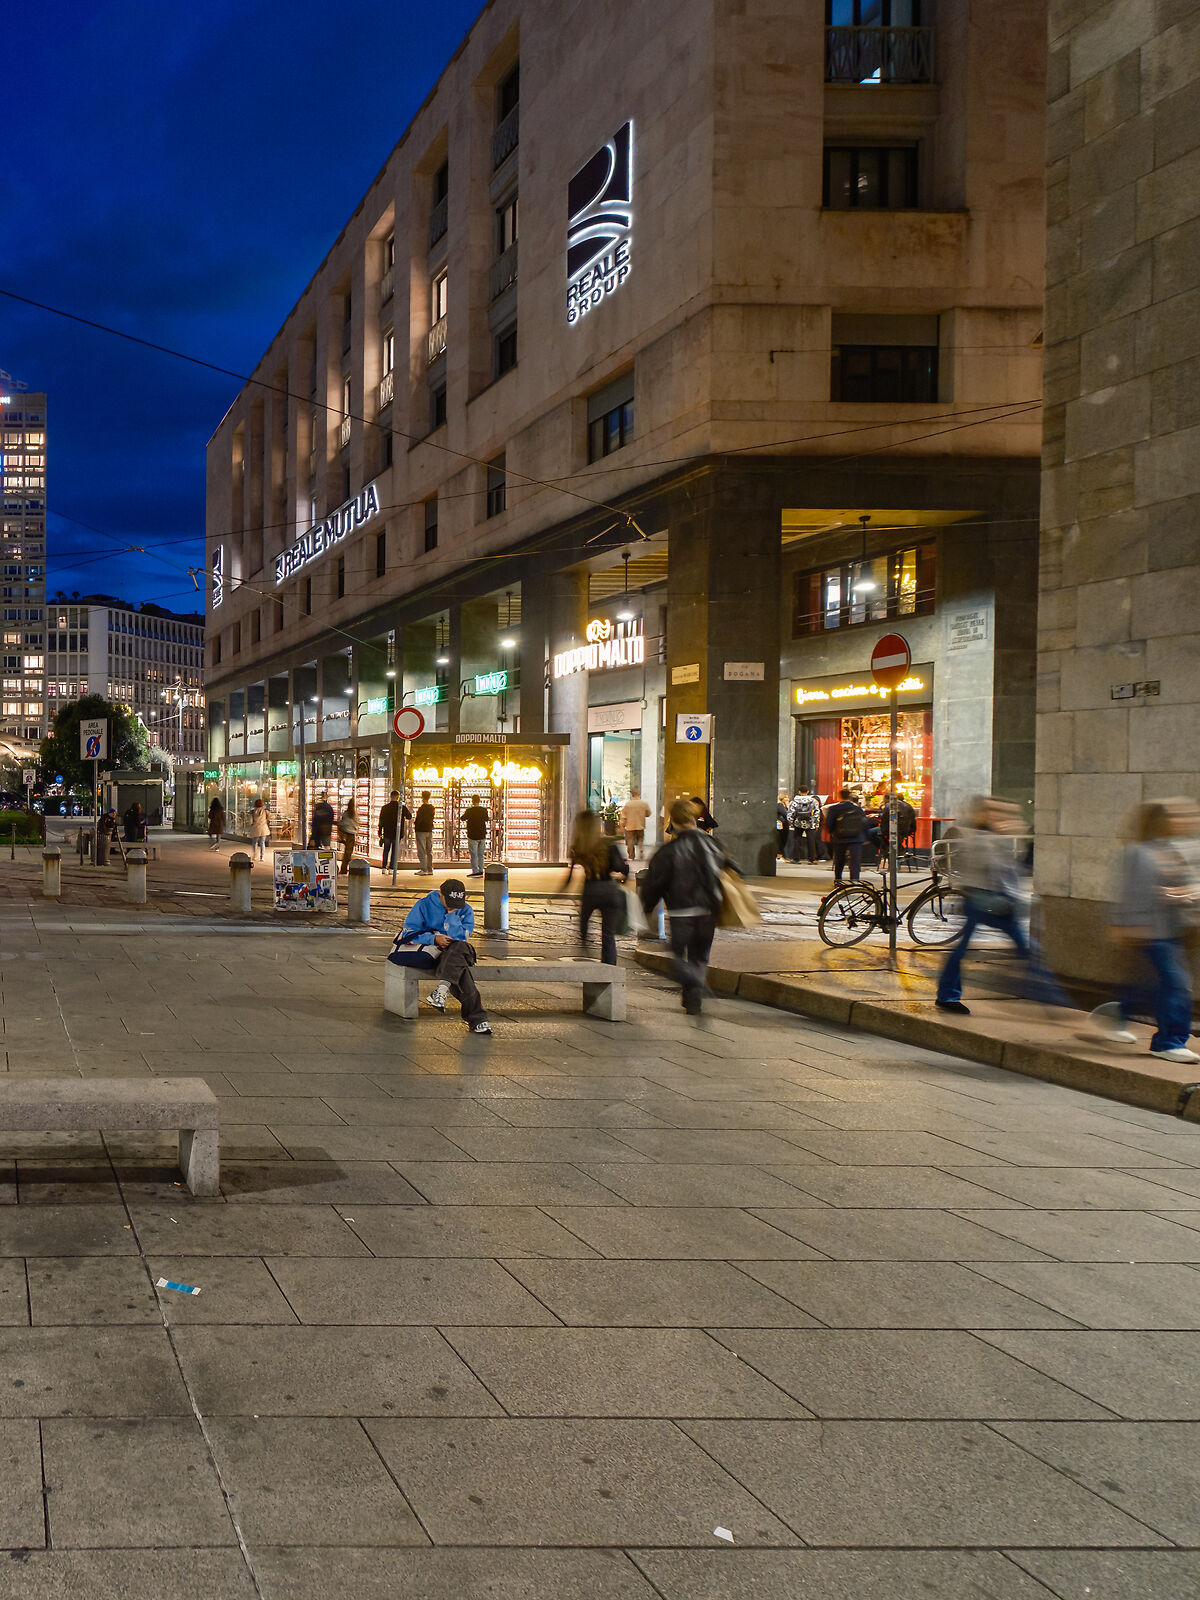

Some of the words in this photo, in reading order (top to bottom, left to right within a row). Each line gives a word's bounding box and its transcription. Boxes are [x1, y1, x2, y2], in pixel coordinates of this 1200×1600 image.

[566, 236, 632, 309] REALE
[566, 264, 632, 325] GROUP
[284, 525, 324, 577] REALE
[324, 484, 380, 549] MUTUA
[554, 644, 598, 679] DOPPIO
[598, 635, 645, 669] MALTO
[455, 734, 483, 744] DOPPIO
[483, 734, 507, 744] MALTO
